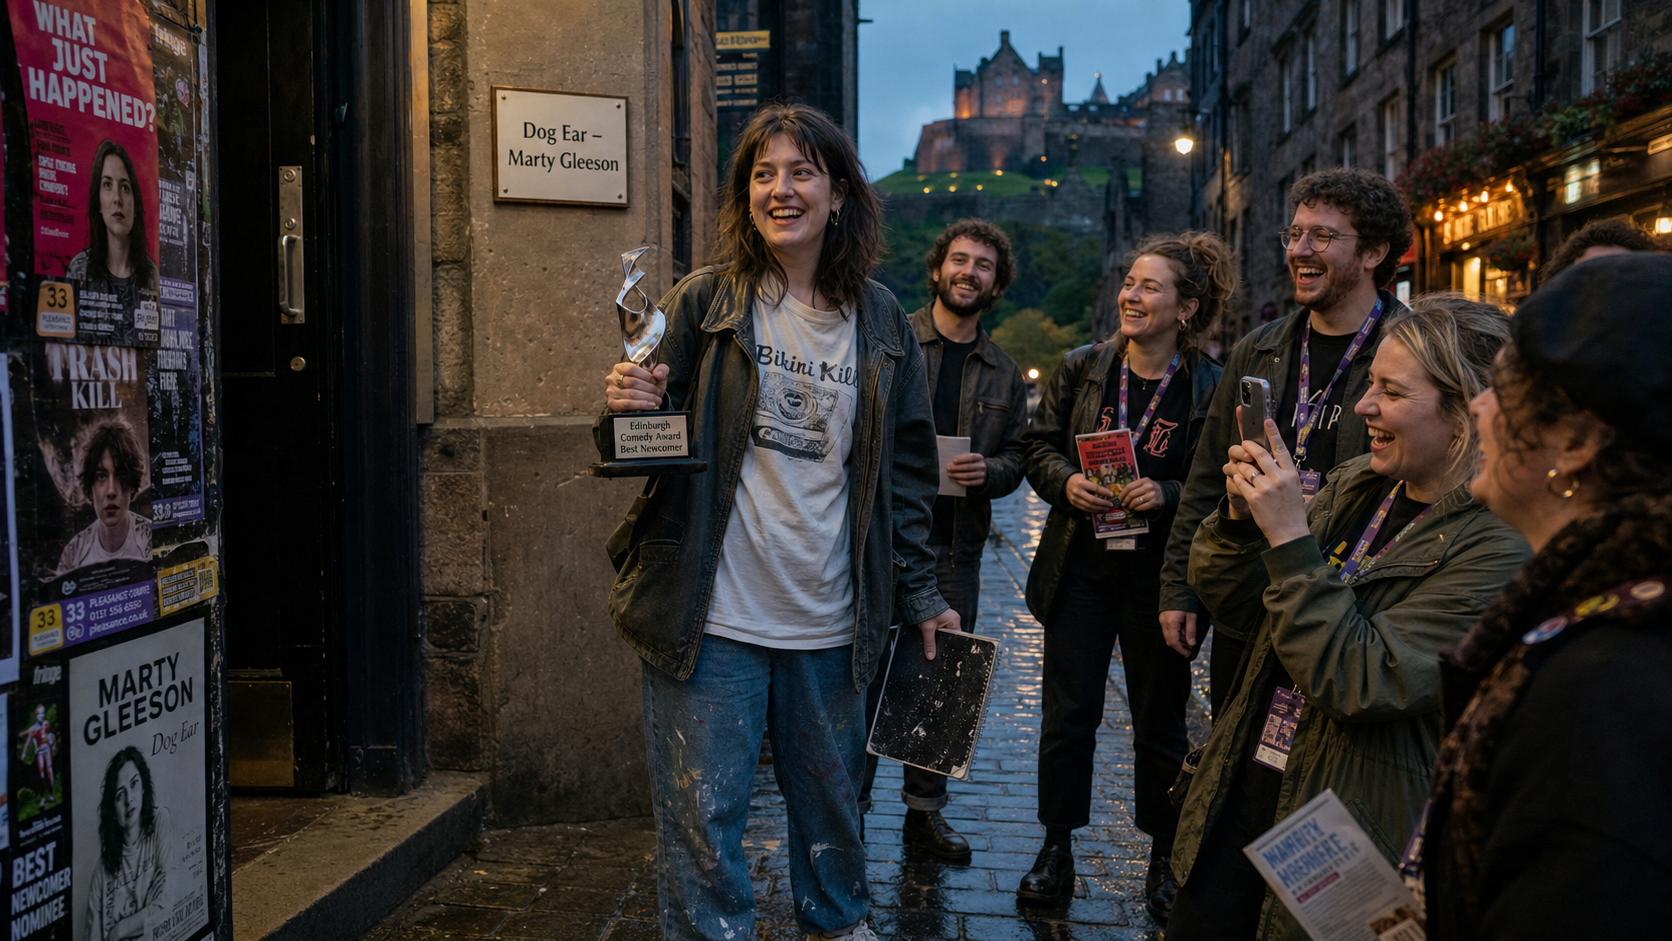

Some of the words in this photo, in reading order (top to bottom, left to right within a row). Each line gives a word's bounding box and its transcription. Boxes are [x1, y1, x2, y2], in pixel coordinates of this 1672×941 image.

[33, 0, 97, 46] WHAT
[154, 23, 187, 57] fringe
[51, 37, 108, 84] JUST
[28, 66, 156, 132] HAPPENED?
[523, 121, 557, 145] Dog
[562, 124, 587, 142] Ear
[508, 149, 555, 173] Marty
[560, 152, 619, 172] Gleeson
[46, 287, 67, 309] 33
[46, 343, 138, 381] TRASH
[756, 344, 815, 377] Bikini
[819, 360, 858, 389] Kill
[71, 381, 123, 410] KILL
[620, 432, 653, 443] Comedy
[656, 431, 681, 441] Award
[630, 420, 671, 432] Edinburgh
[620, 445, 638, 454] Best
[641, 444, 683, 453] Newcomer
[37, 609, 56, 629] 33
[66, 601, 86, 623] 33
[32, 665, 62, 685] fringe
[99, 652, 180, 708] MARTY
[83, 676, 193, 746] GLEESON
[151, 730, 177, 756] Dog
[181, 720, 200, 742] Ear
[12, 840, 57, 889] BEST
[11, 866, 72, 916] NEWCOMER
[11, 894, 66, 941] NOMINEE
